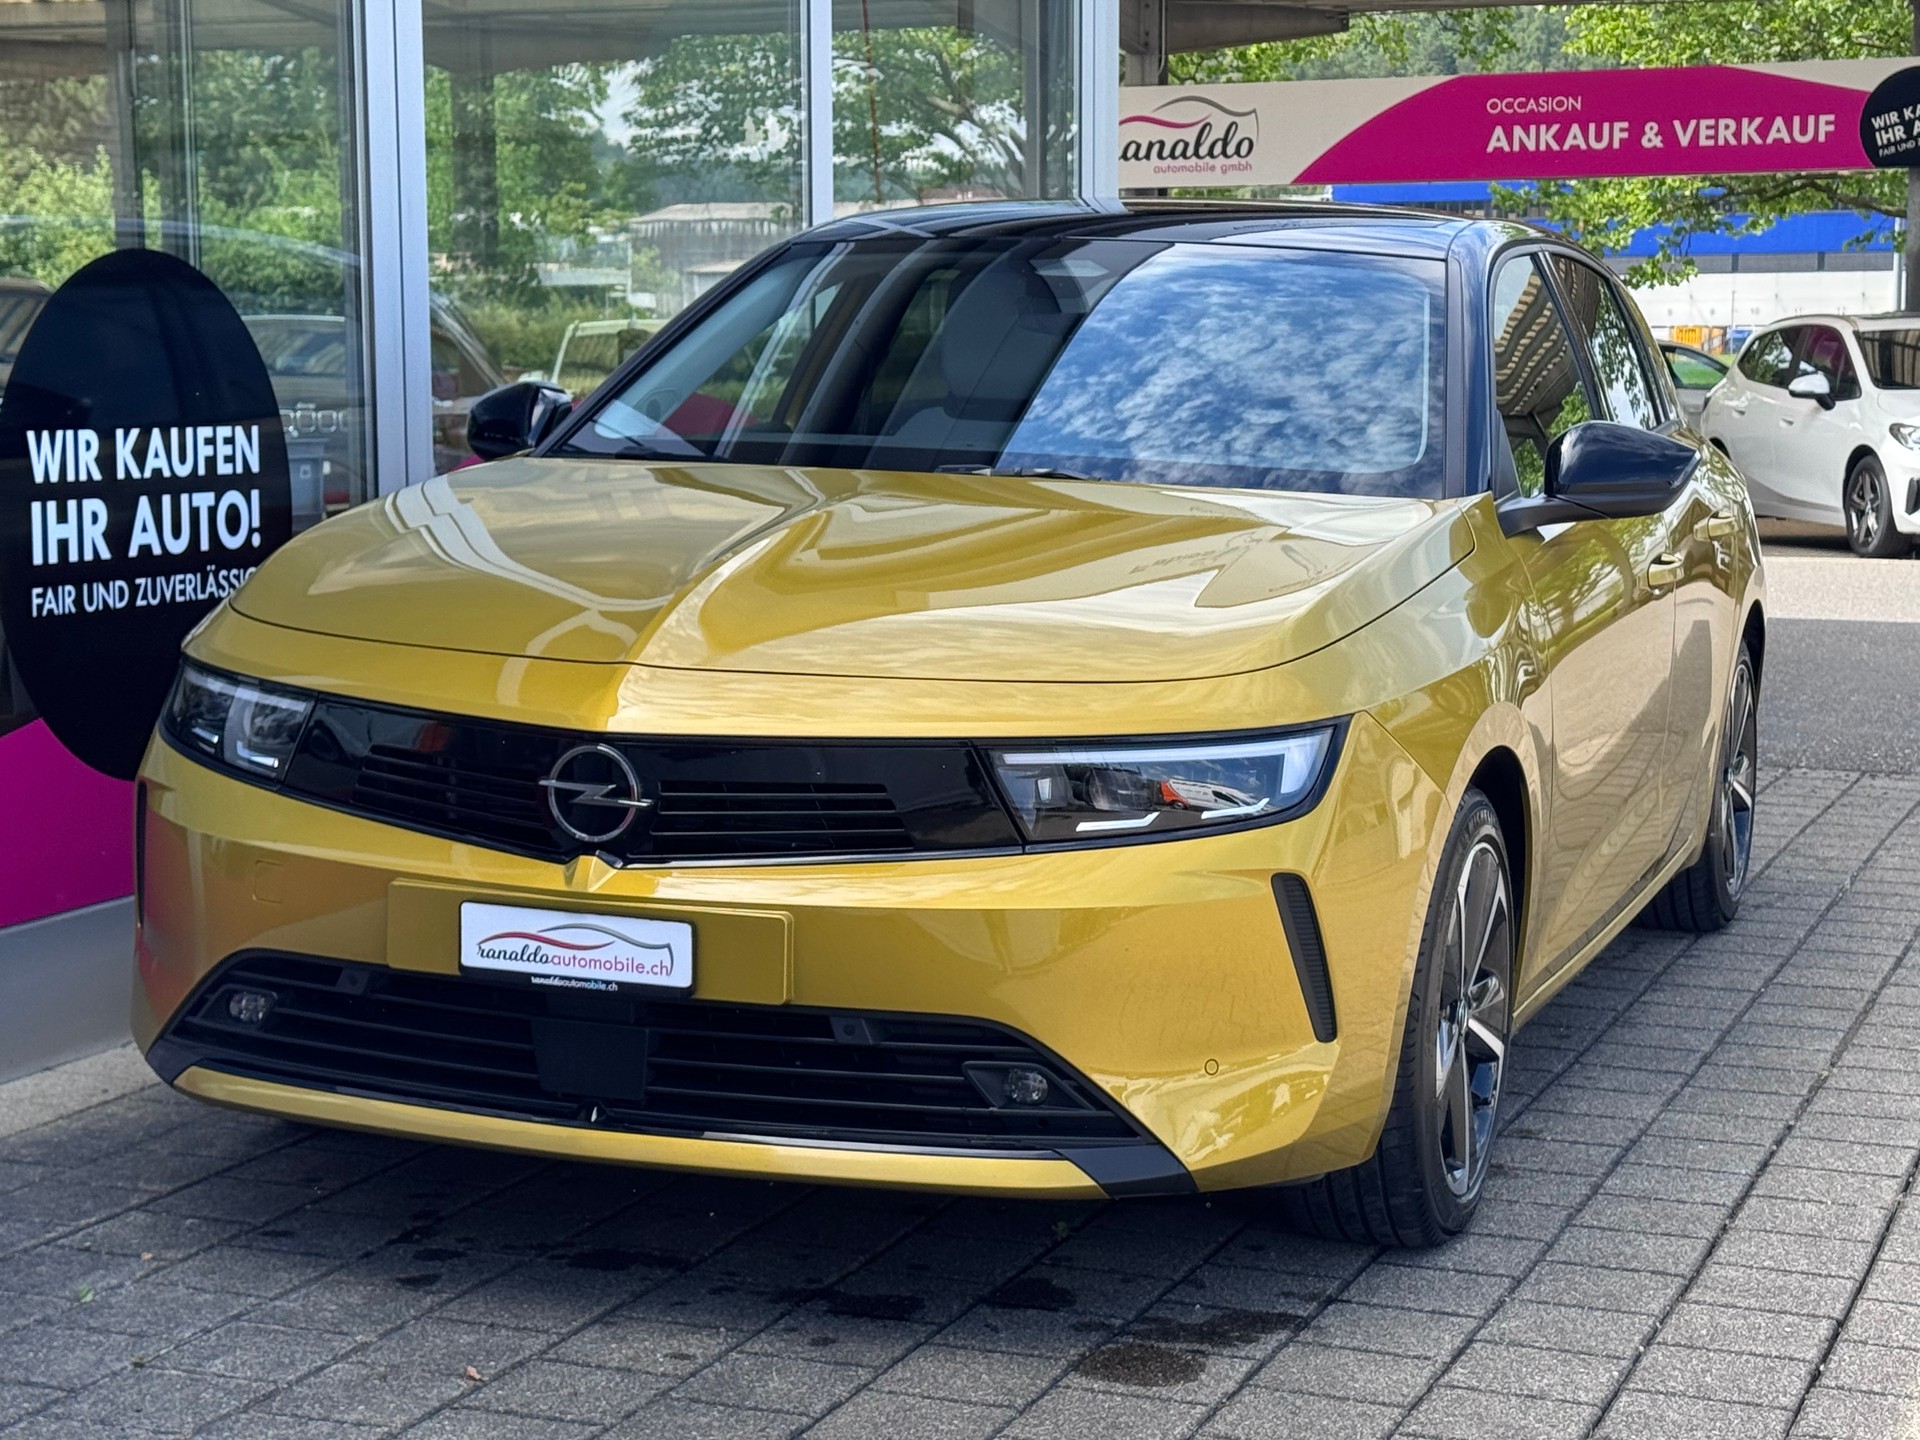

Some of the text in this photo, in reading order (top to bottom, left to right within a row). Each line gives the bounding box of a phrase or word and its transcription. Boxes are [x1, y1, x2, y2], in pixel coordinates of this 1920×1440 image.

[1486, 95, 1582, 114] OCCASION
[1871, 110, 1900, 129] WIR
[1119, 120, 1255, 161] analdo
[1486, 114, 1836, 153] ANKAUF & VERKAUF
[1875, 125, 1907, 147] IHR
[1878, 145, 1896, 158] FAIR
[1897, 139, 1916, 152] UND
[1153, 160, 1253, 175] automobile gmbh
[26, 424, 260, 484] WIR KAUFEN
[30, 489, 261, 566] IHR AUTO!
[31, 584, 76, 618] FAIR
[82, 580, 130, 613] UND
